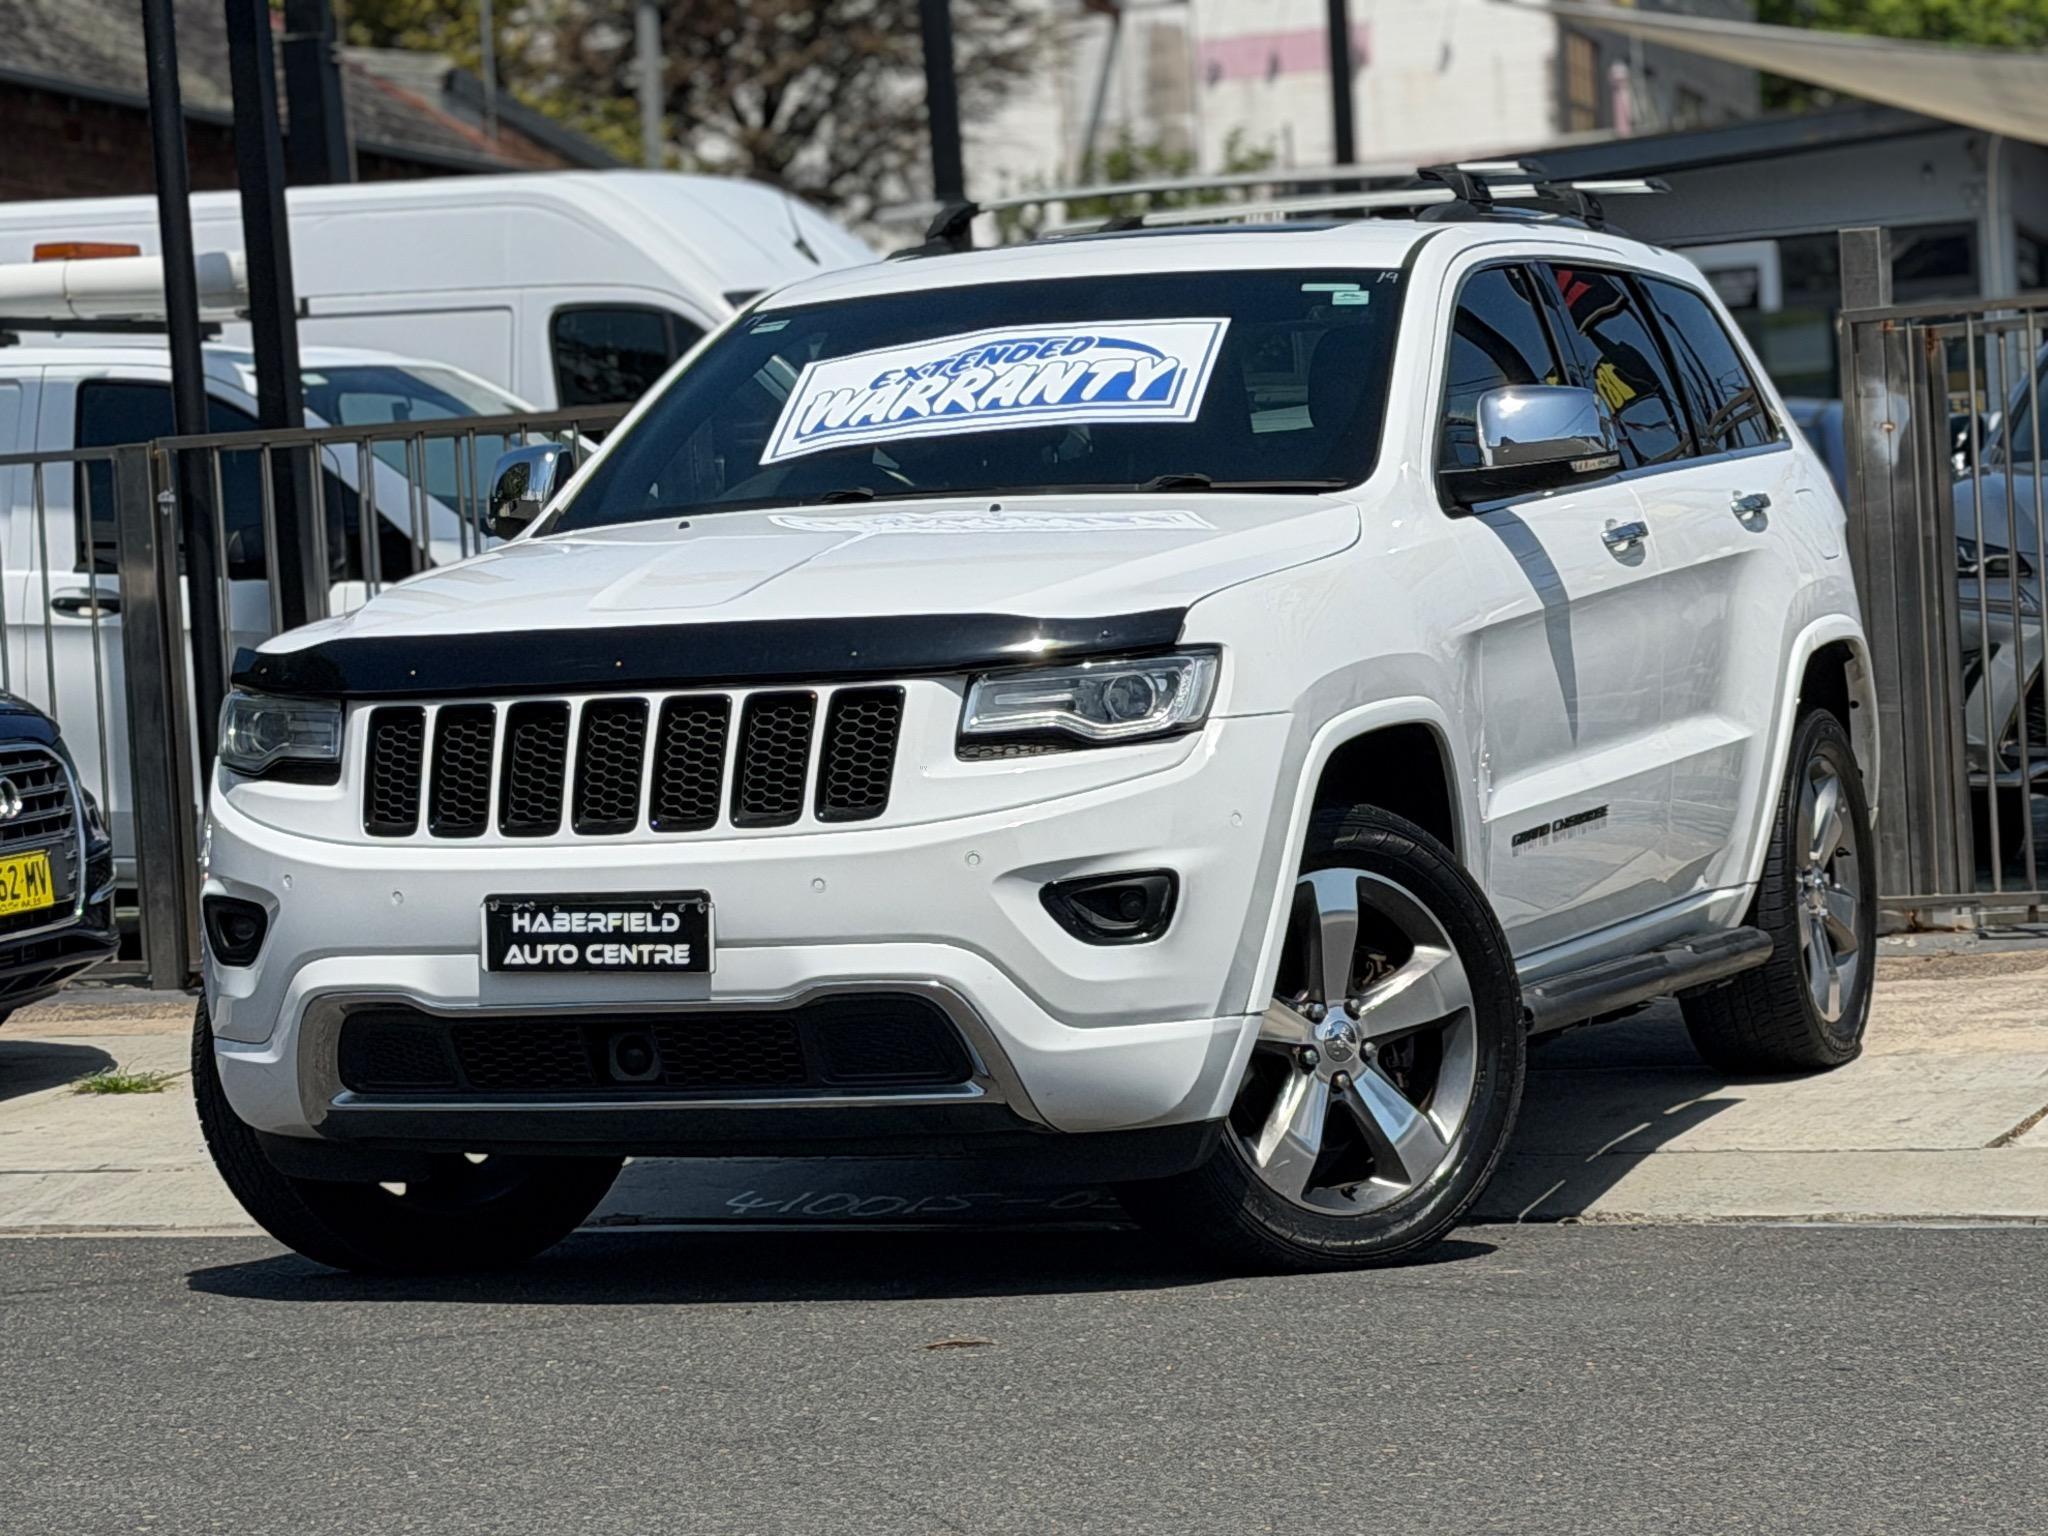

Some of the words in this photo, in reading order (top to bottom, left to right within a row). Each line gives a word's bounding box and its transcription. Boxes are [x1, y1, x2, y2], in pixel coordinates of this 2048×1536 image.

[870, 336, 1096, 391] EXTENDED
[801, 358, 1178, 434] WARRANTY
[512, 912, 680, 933] HABERFIELD
[503, 944, 578, 965] AUTO
[585, 944, 690, 965] CENTRE
